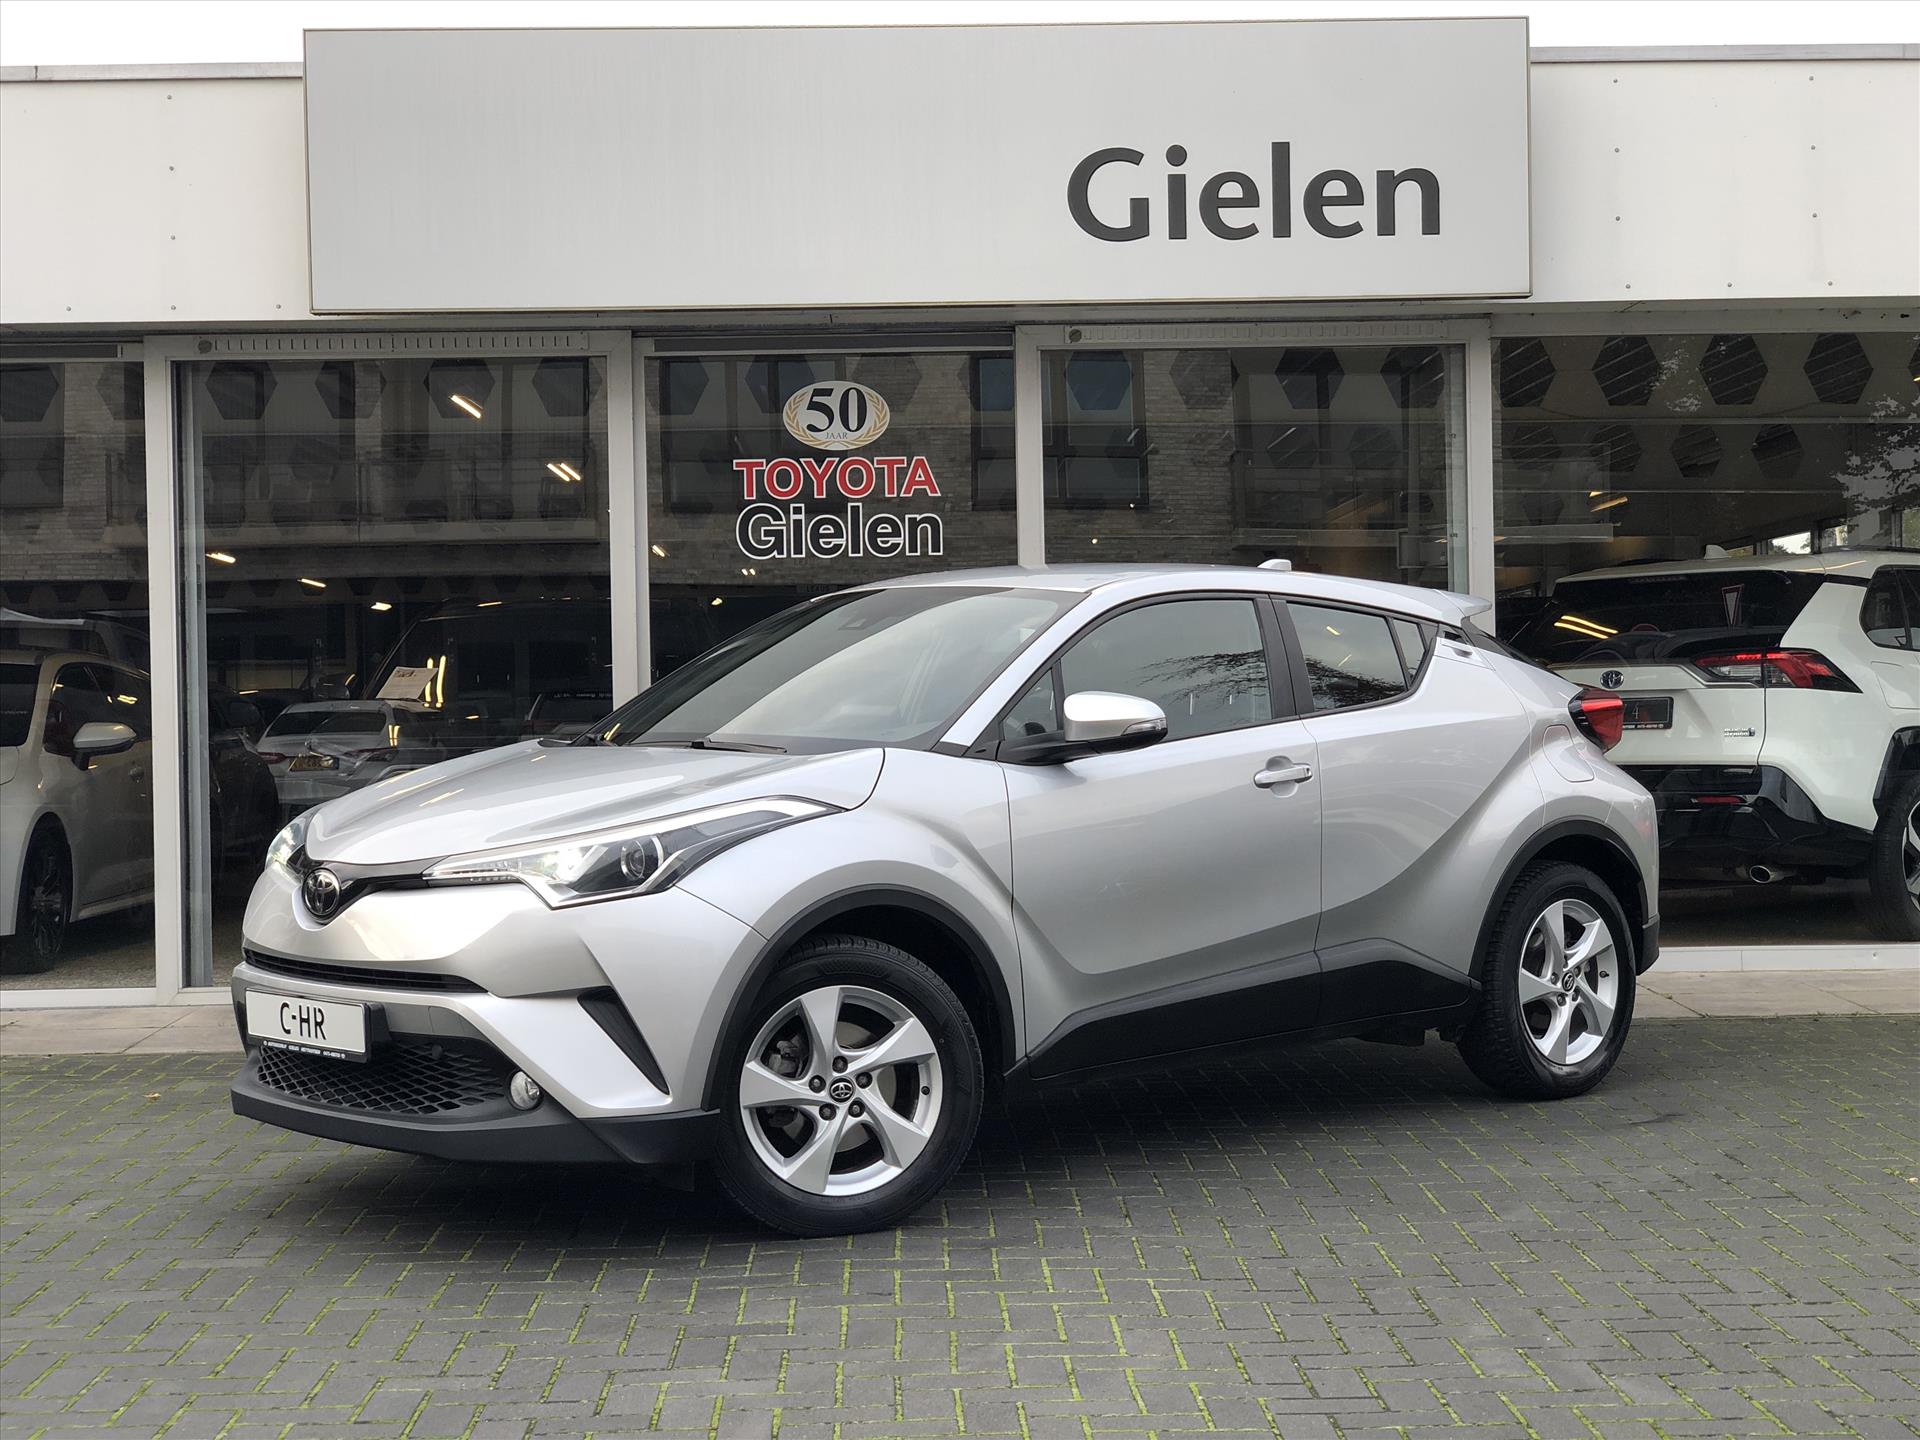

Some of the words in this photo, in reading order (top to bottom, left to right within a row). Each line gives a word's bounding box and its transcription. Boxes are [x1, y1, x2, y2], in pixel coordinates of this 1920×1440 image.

[1067, 141, 1440, 242] Gielen
[806, 387, 868, 433] 50
[824, 431, 848, 440] JAAR
[733, 456, 941, 500] TOYOTA
[735, 502, 943, 560] Gielen
[280, 1002, 326, 1040] C-HR
